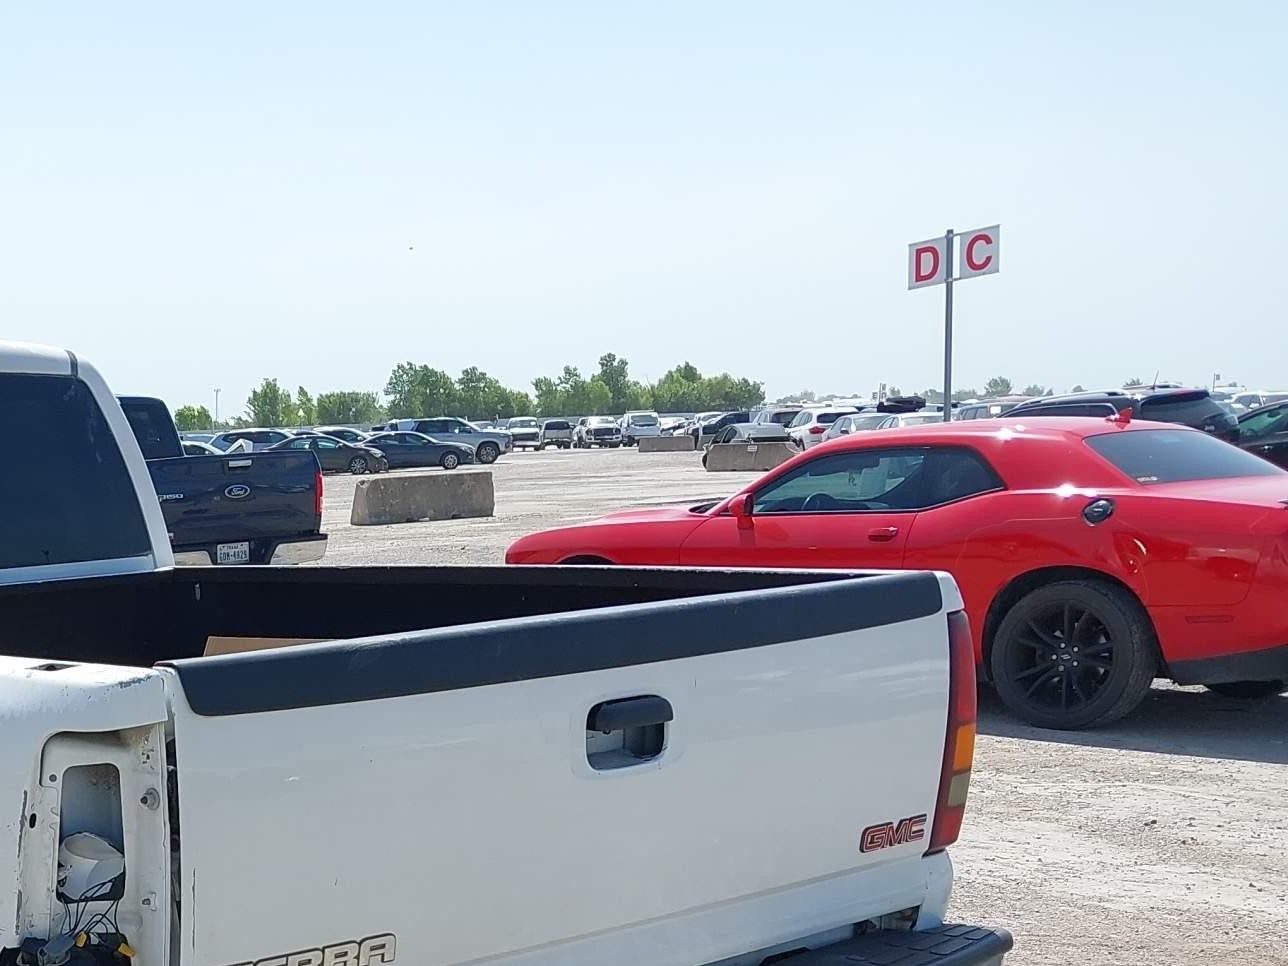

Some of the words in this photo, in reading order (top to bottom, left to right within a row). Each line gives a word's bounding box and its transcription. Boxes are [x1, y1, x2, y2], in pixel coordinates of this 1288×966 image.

[915, 246, 940, 283] D
[966, 234, 993, 271] C
[859, 812, 927, 853] GMC
